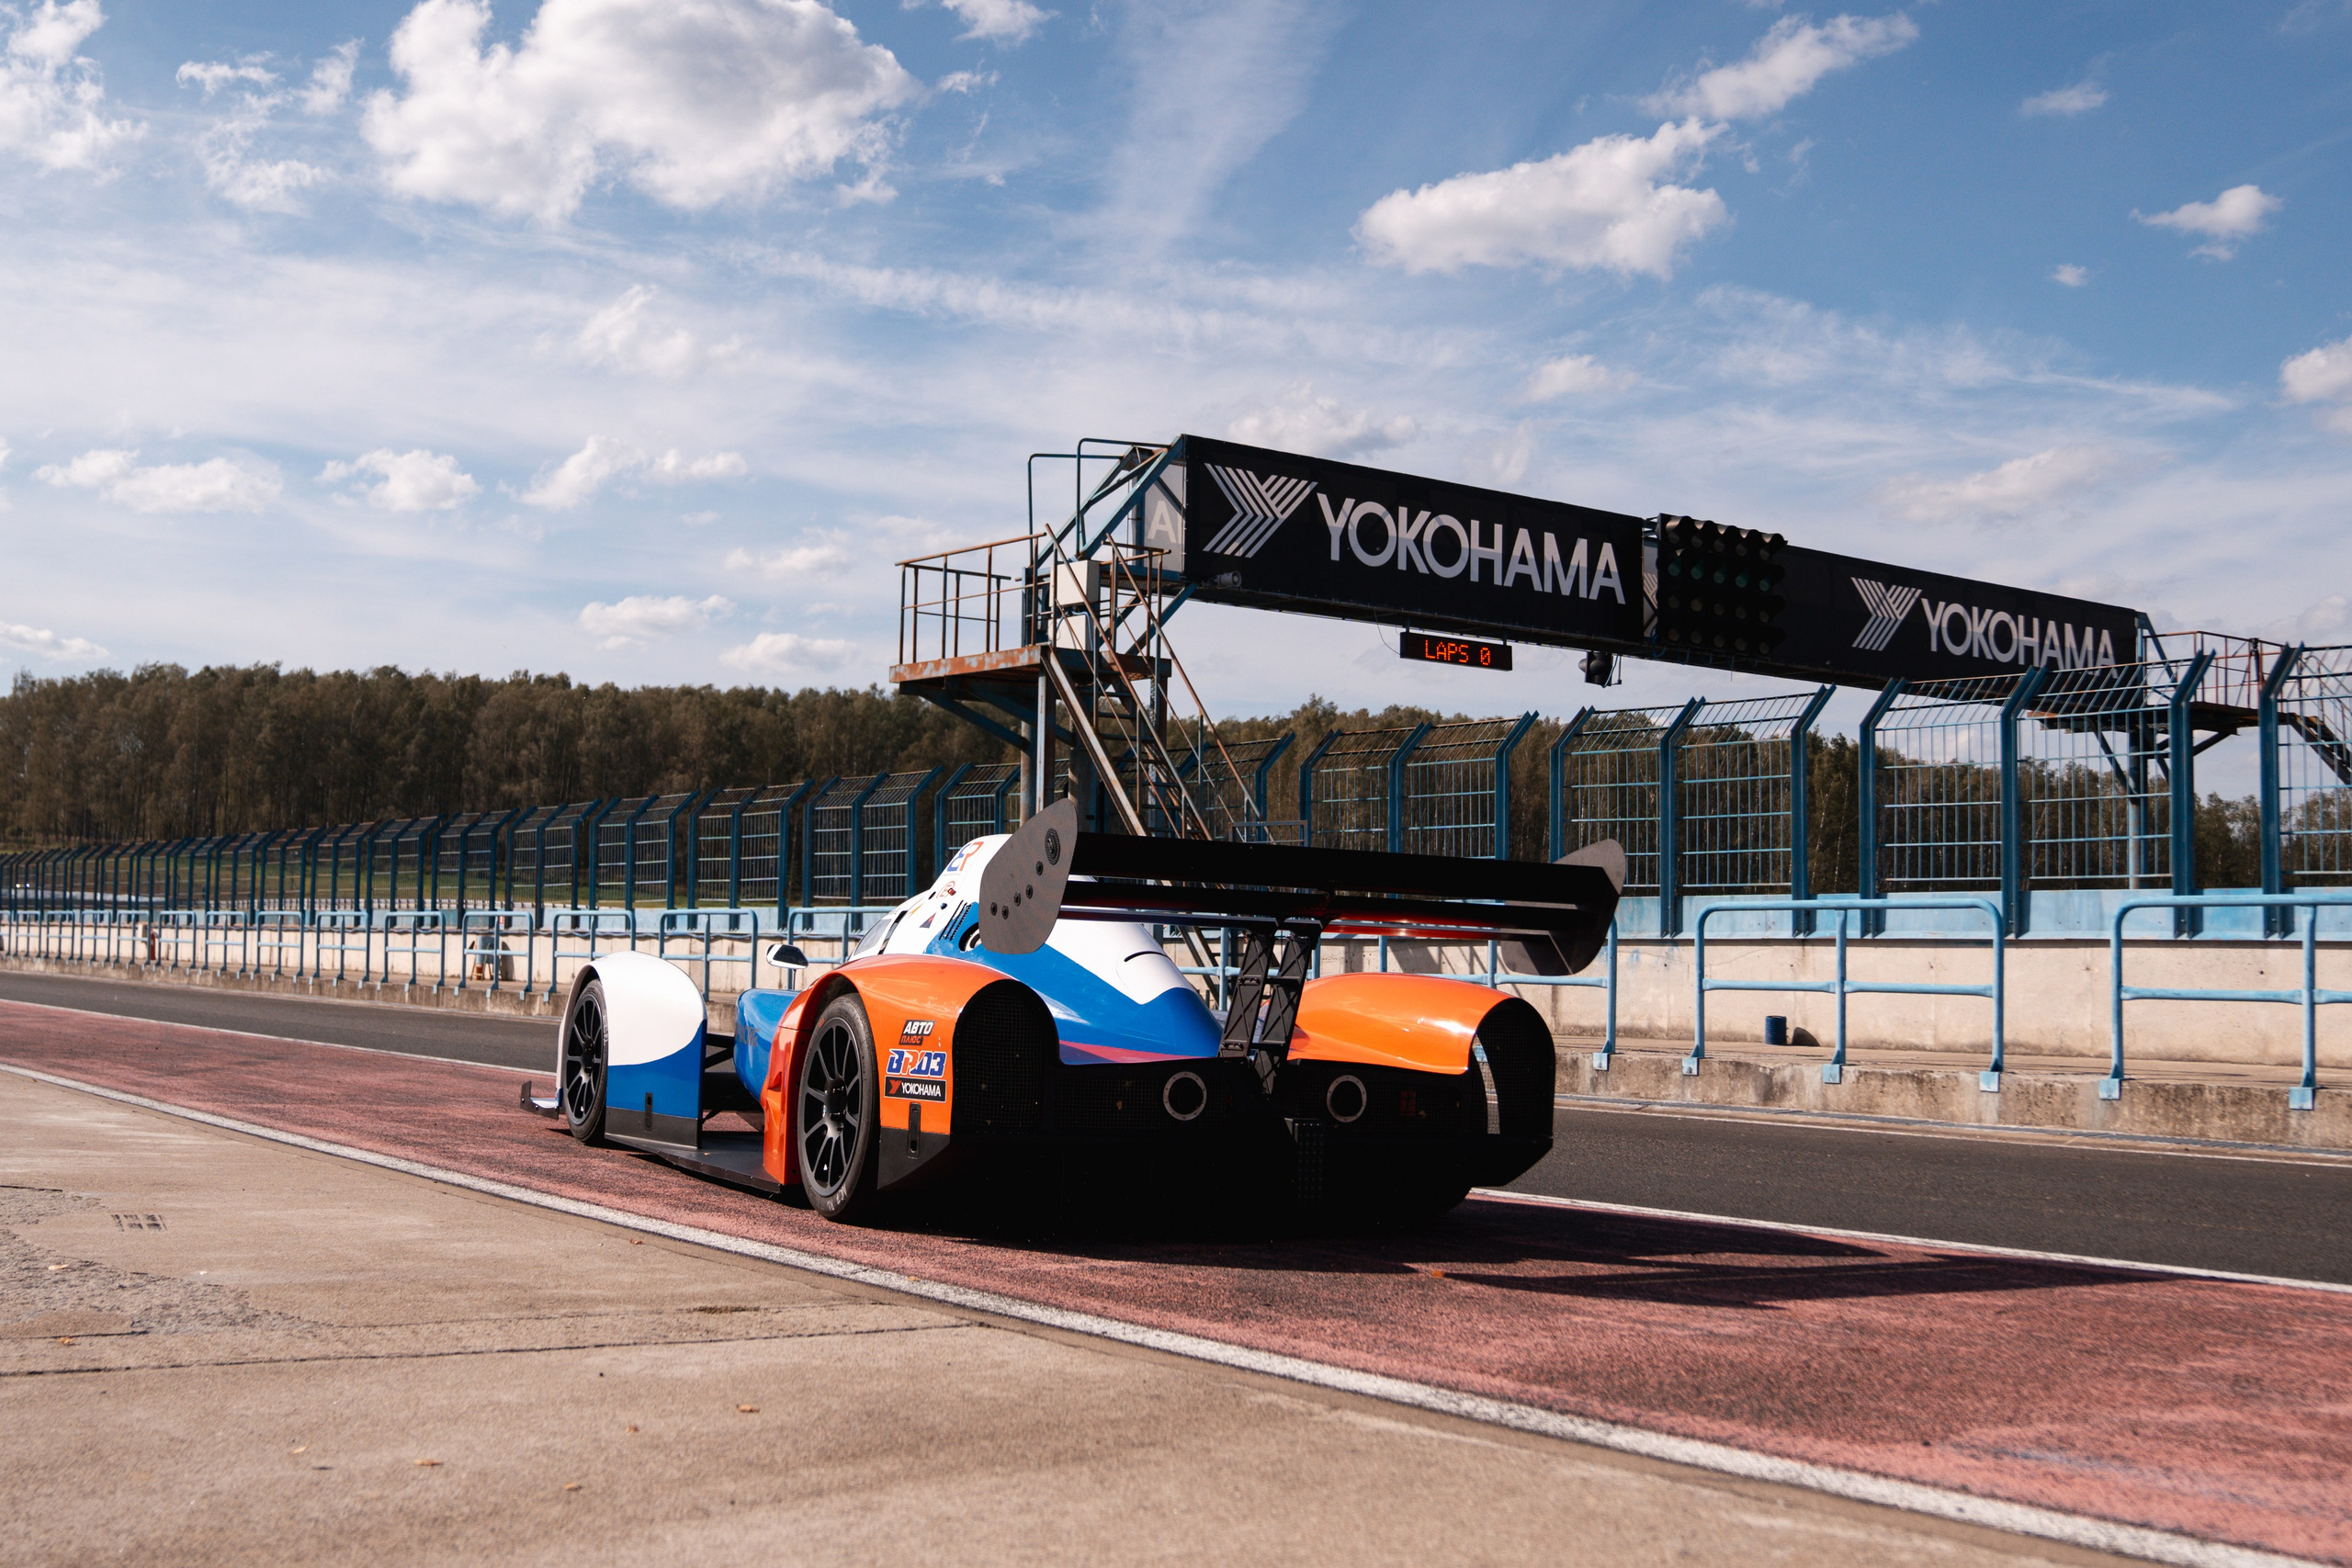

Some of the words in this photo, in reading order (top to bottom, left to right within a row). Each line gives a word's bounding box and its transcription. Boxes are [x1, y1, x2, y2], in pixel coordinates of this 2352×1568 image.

[1317, 492, 1626, 605] YOKOHAMA
[1920, 598, 2119, 679] YOKOHAMA
[1425, 639, 1469, 662] LAPS
[1480, 647, 1490, 666] 0
[903, 1021, 934, 1034] АВТО
[901, 1082, 942, 1098] YOKOHAMA
